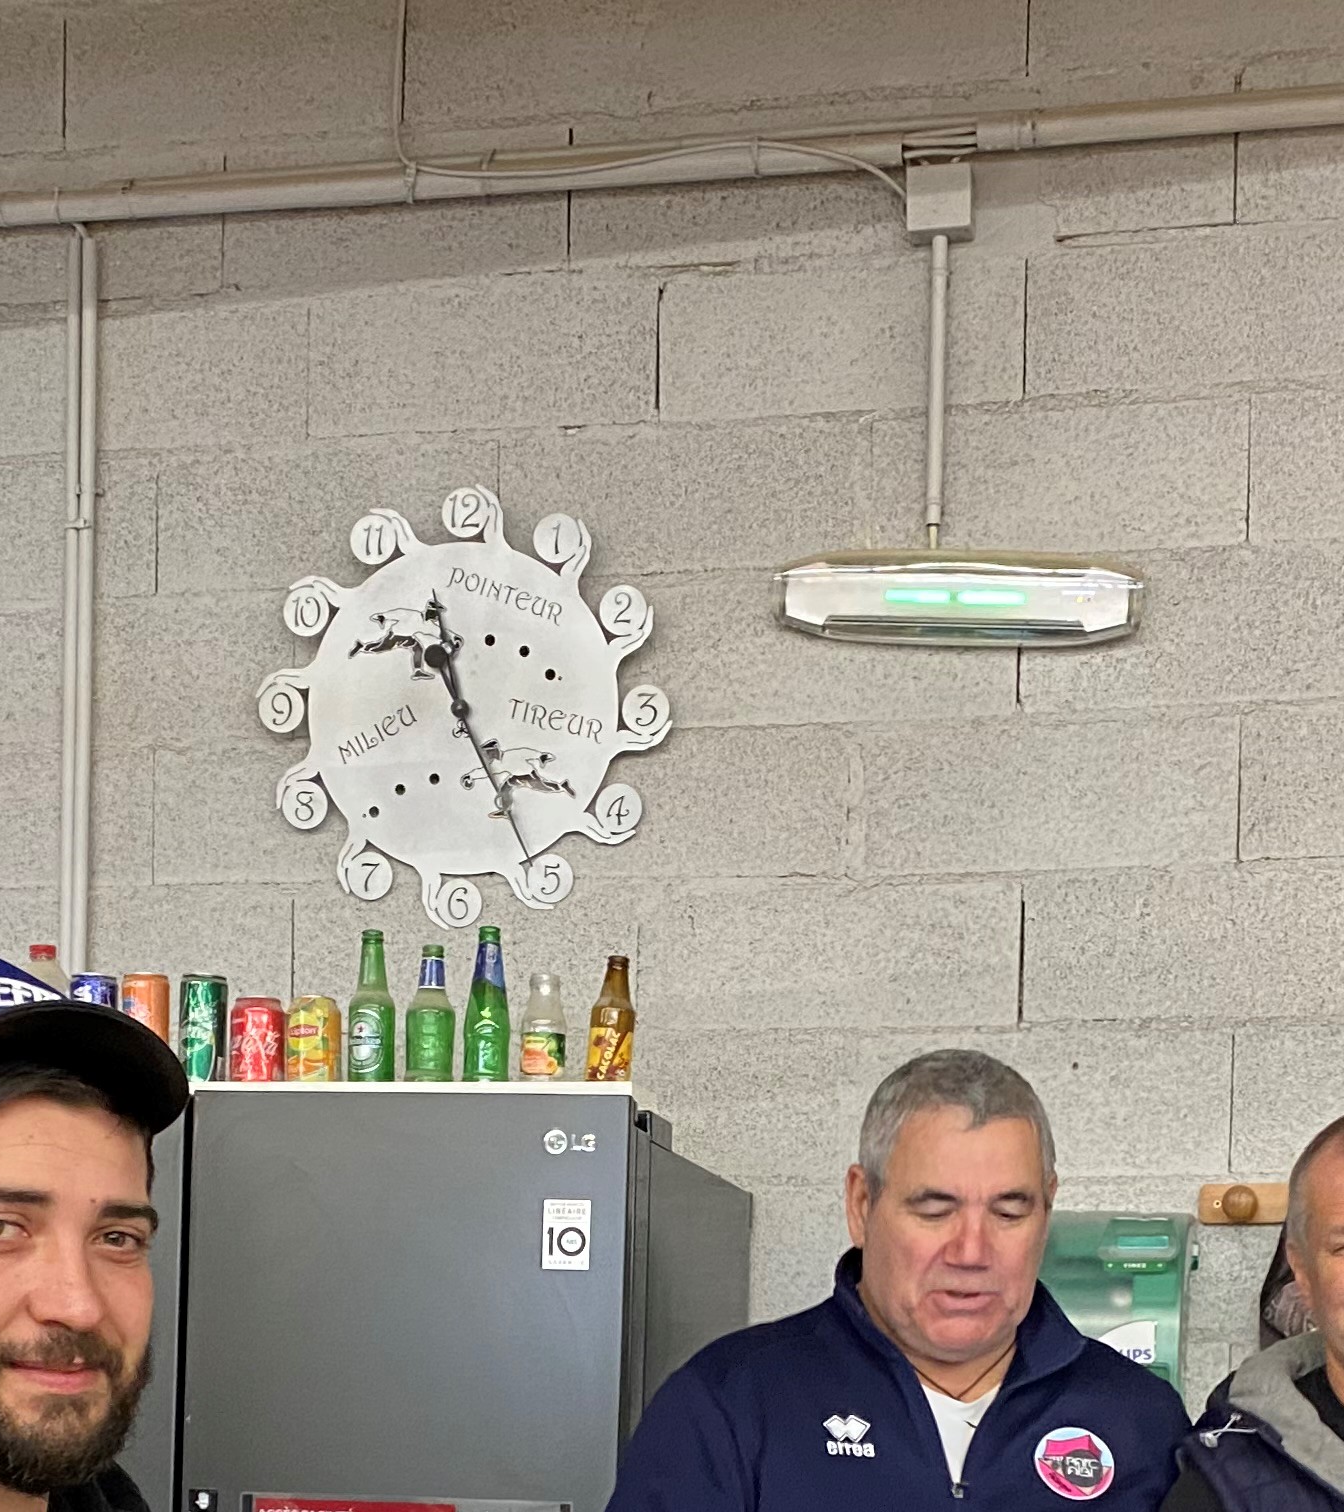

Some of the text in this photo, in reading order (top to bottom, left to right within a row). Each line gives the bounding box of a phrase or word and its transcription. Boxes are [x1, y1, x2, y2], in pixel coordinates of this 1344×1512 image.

[448, 493, 481, 529] 12
[362, 523, 387, 558] 11
[551, 522, 563, 555] 1
[291, 595, 320, 630] 10
[446, 566, 563, 627] POINTEUR
[612, 594, 633, 624] 2
[271, 691, 293, 727] 9
[508, 698, 604, 745] TIREUR
[635, 692, 660, 727] 3
[337, 704, 419, 765] MILIEU
[294, 790, 316, 823] 8
[605, 794, 631, 827] 4
[360, 862, 381, 893] 7
[540, 863, 563, 895] 5
[446, 888, 469, 922] 6
[570, 1133, 596, 1152] LG
[547, 1226, 587, 1257] 10
